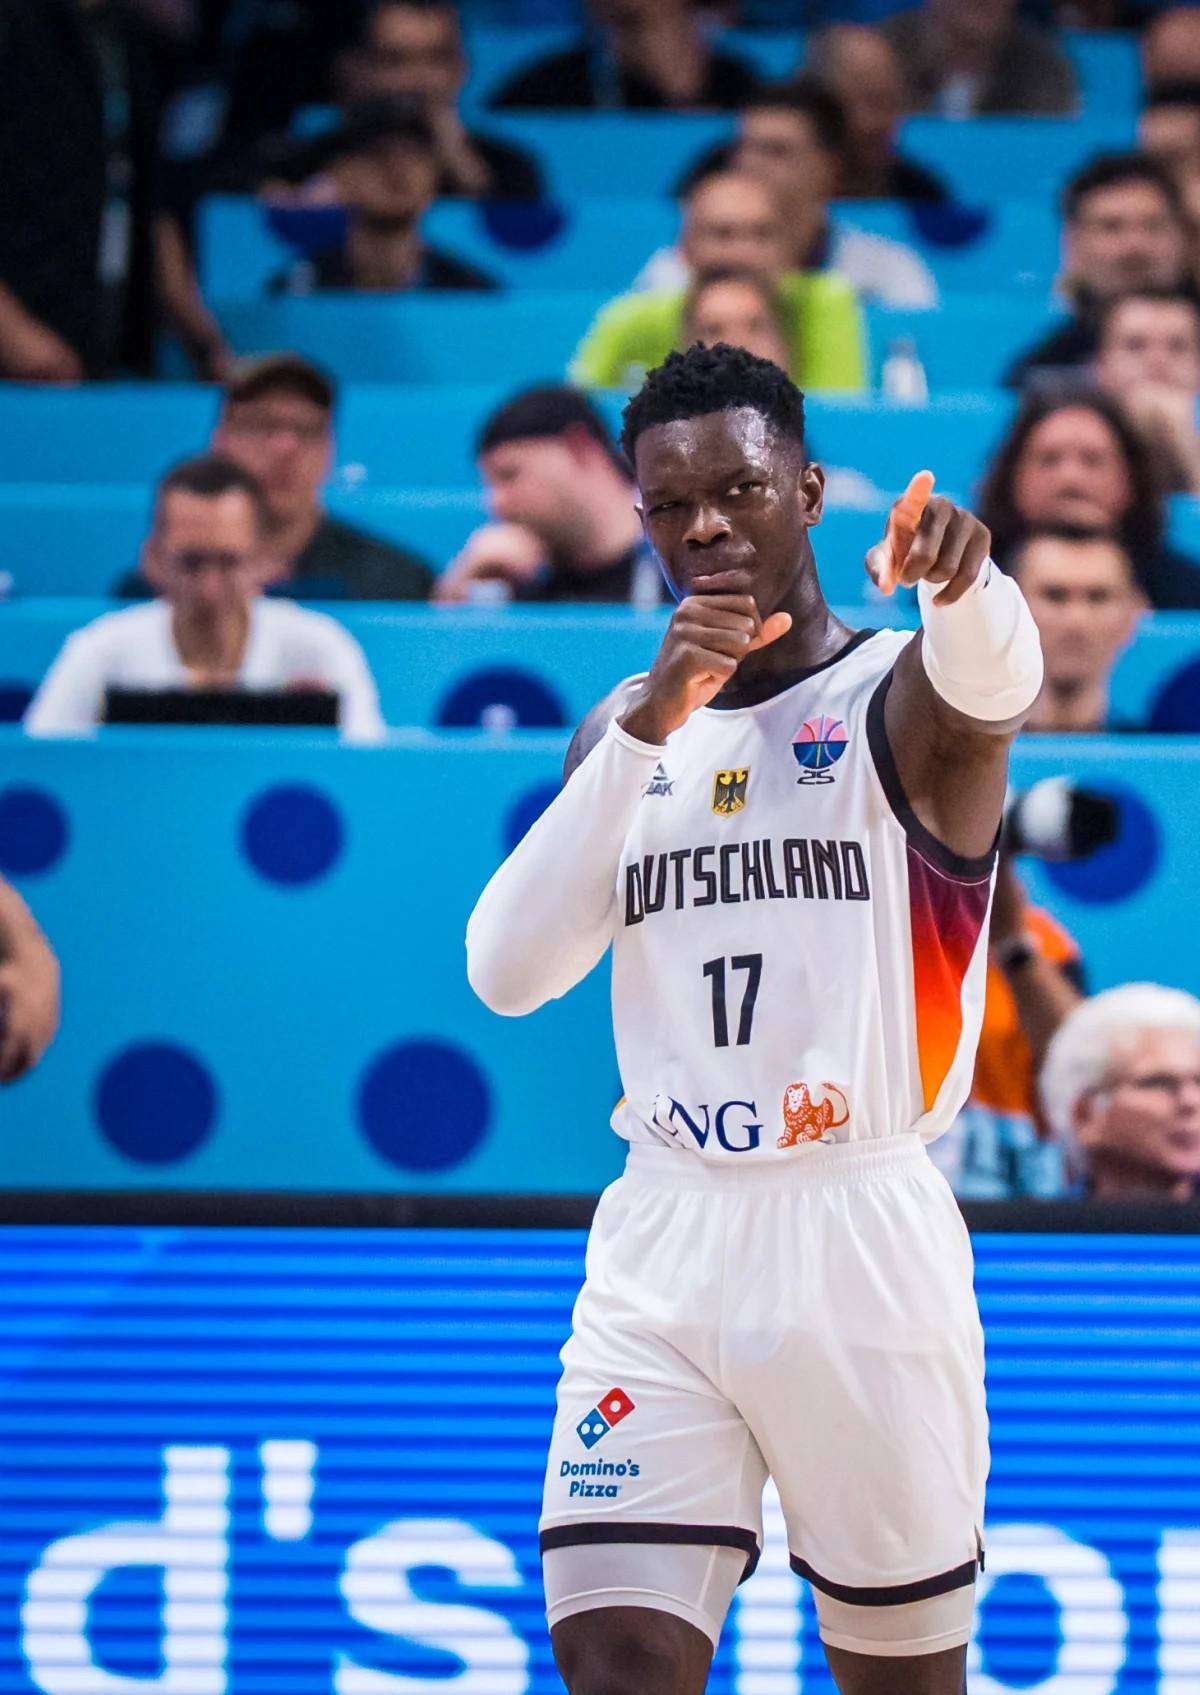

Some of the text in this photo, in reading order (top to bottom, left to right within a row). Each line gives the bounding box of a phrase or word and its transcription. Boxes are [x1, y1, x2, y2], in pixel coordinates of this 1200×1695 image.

[703, 953, 763, 1047] 17
[560, 1458, 640, 1477] Domino's
[569, 1479, 619, 1497] Pizza
